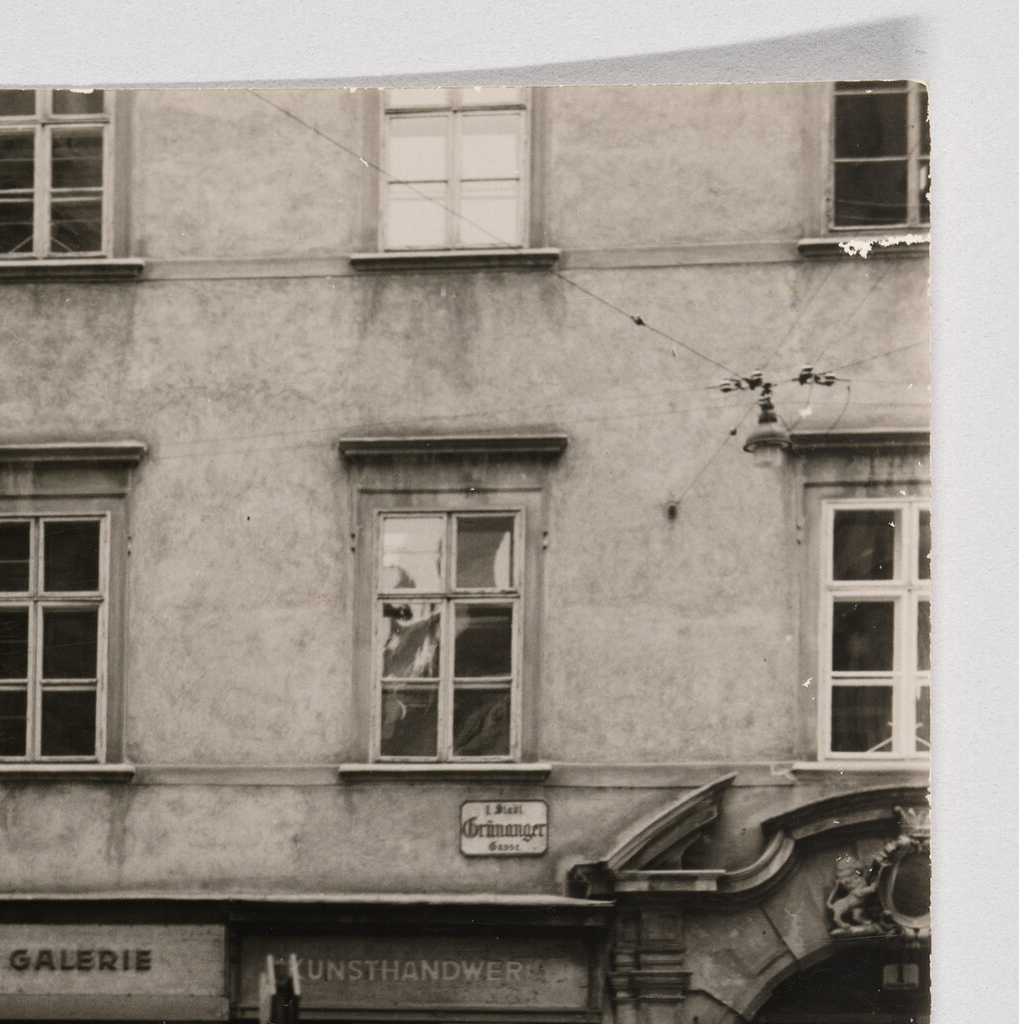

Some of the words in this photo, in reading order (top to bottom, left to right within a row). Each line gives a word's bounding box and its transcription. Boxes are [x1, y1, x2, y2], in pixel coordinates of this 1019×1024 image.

[462, 816, 546, 842] Grünanger
[9, 948, 152, 971] GALERIE
[289, 959, 541, 982] KUNSTHANDWER
